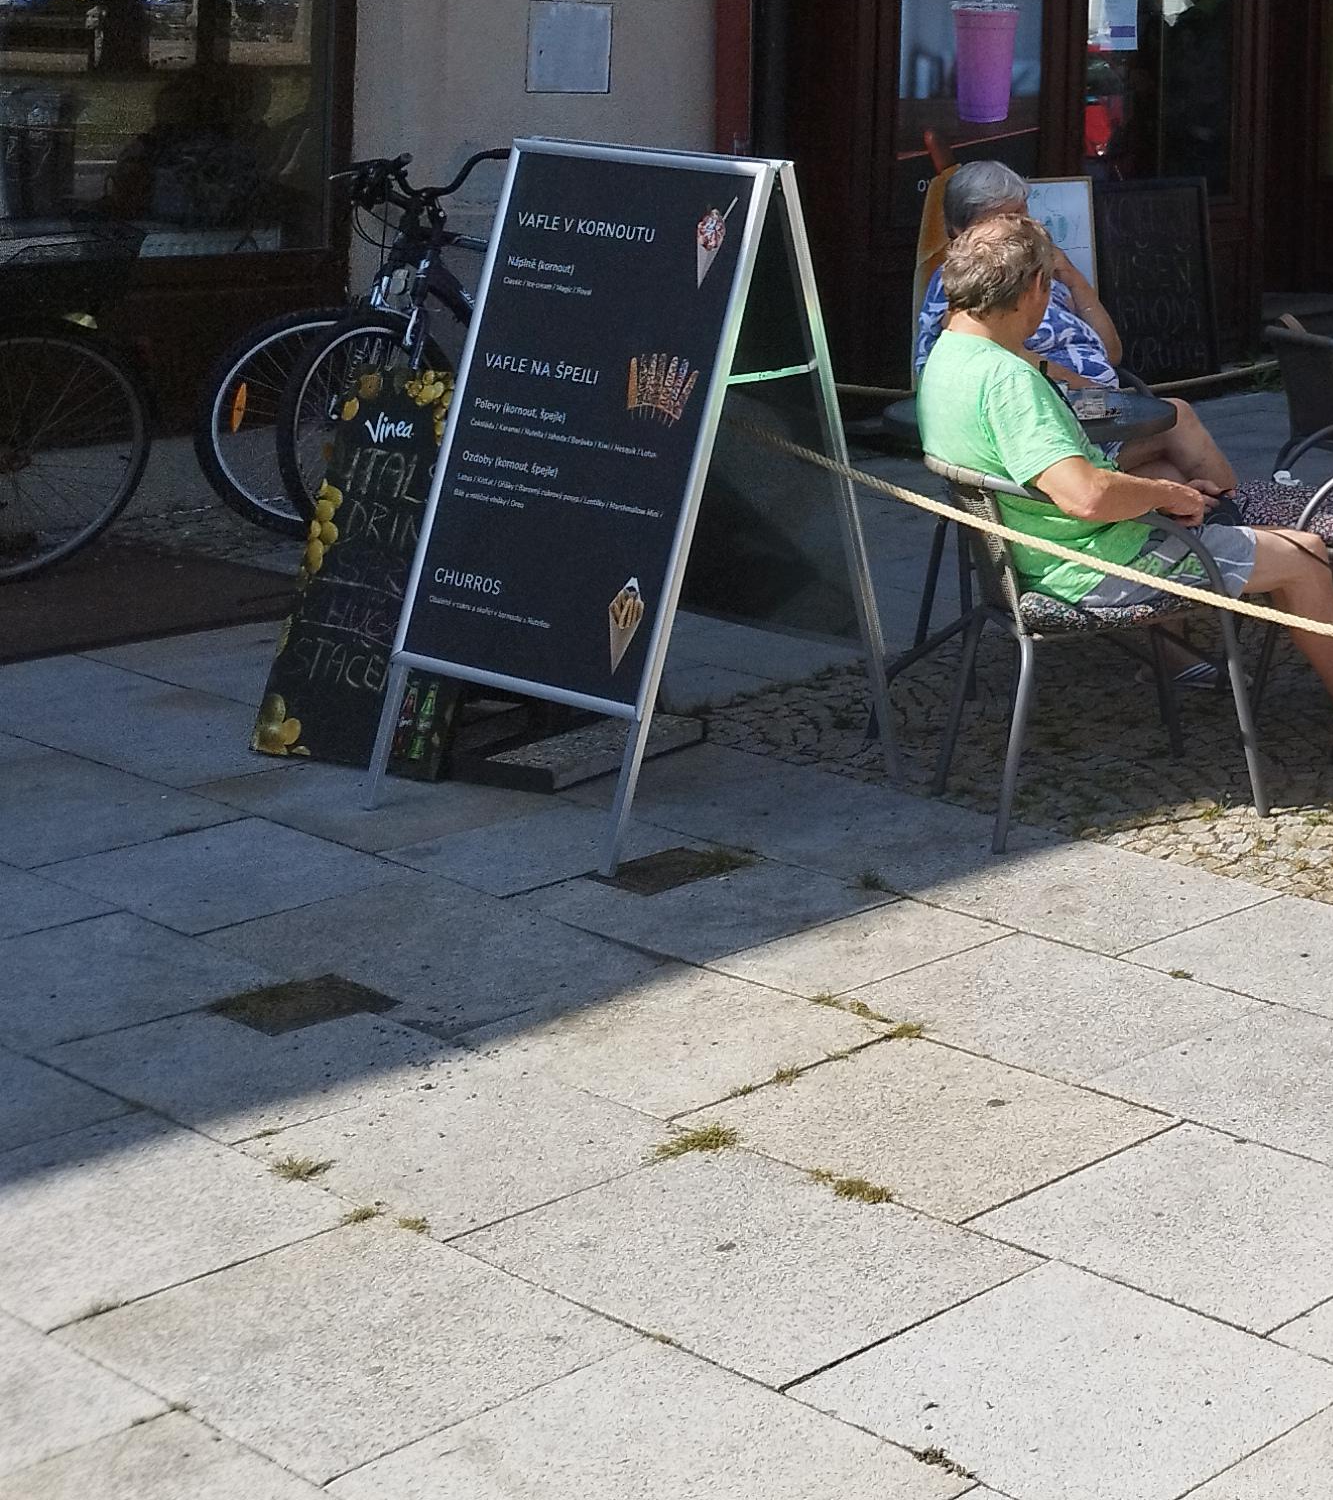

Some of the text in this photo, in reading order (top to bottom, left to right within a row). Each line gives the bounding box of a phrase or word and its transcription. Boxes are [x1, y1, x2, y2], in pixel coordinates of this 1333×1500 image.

[518, 212, 656, 243] VAFLE V KORNOUTU
[485, 352, 600, 385] VAFLE NA ŠPEJLI
[474, 397, 501, 413] Polevy
[364, 411, 414, 444] Vinea
[462, 450, 493, 467] Ozdoby
[434, 567, 502, 595] CHURROS
